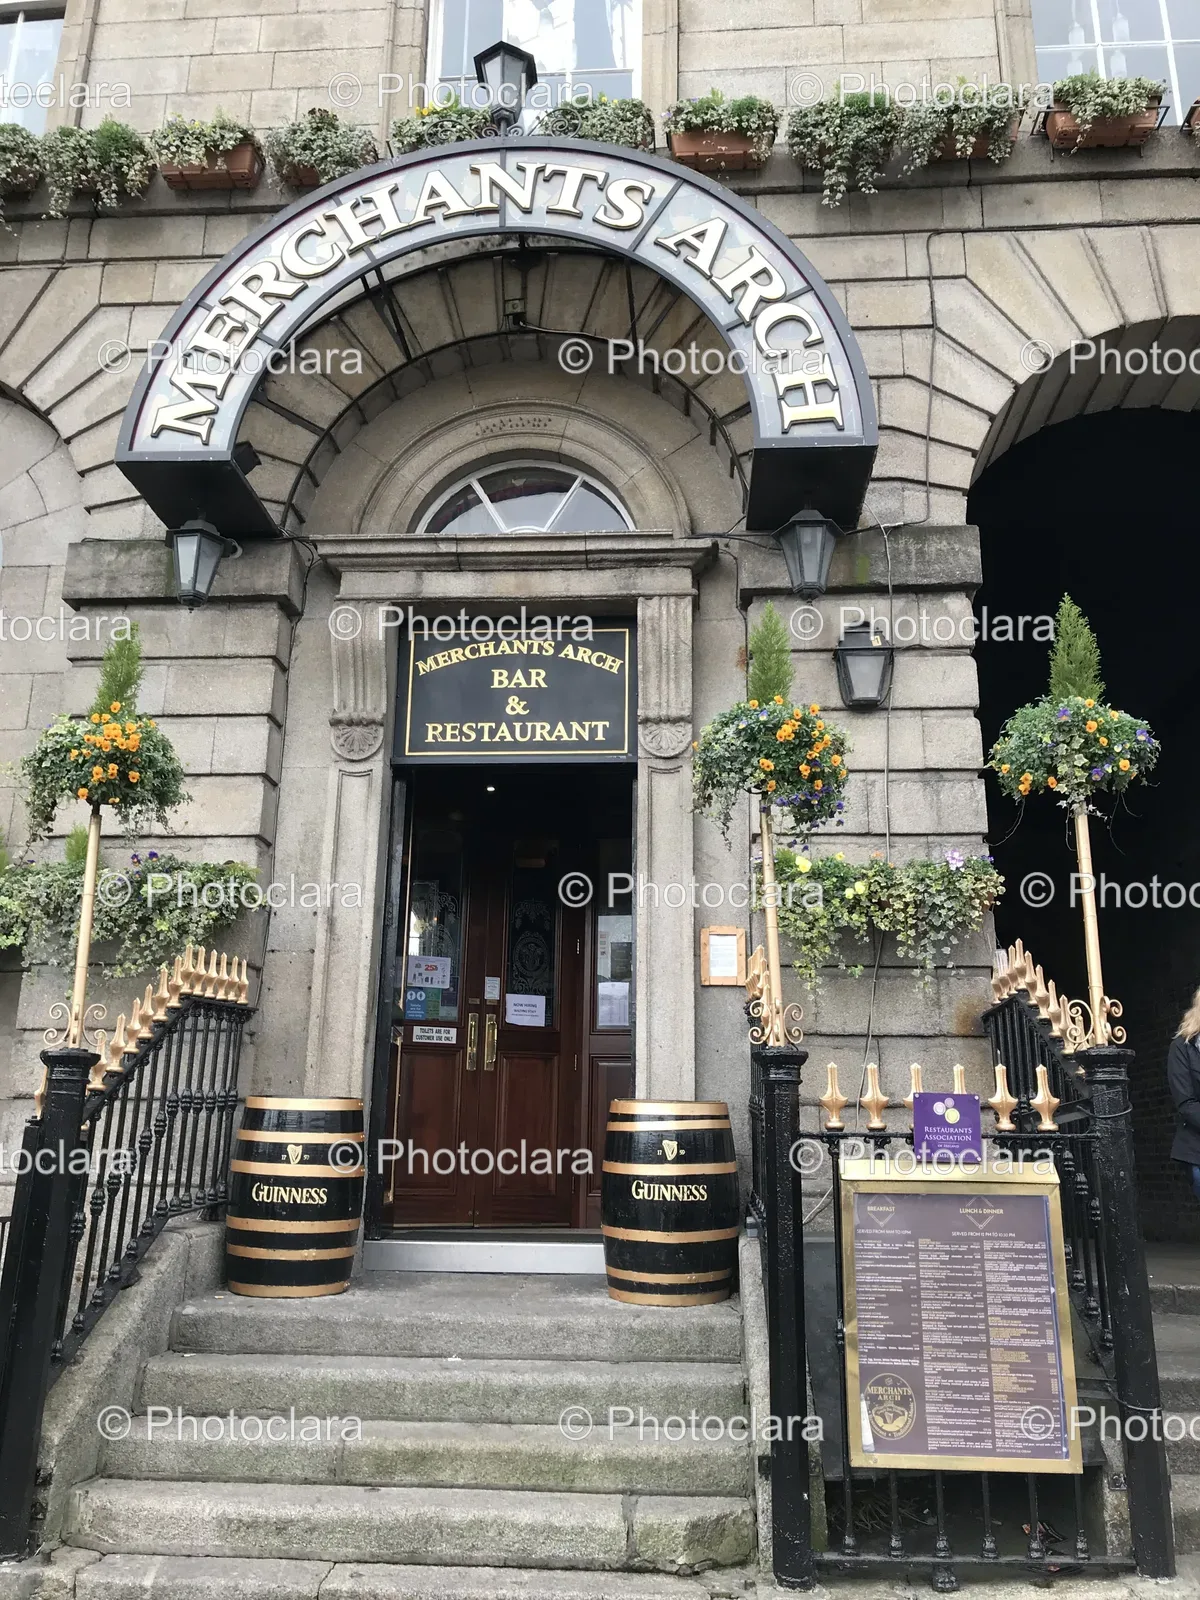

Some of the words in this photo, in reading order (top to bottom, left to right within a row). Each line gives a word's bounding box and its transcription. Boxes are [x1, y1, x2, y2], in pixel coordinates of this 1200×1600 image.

[150, 160, 656, 446] MERCHANTS
[653, 216, 847, 434] ARCH
[415, 639, 555, 676] MERCHANTS
[559, 644, 624, 675] ARCH
[490, 668, 548, 689] BAR
[505, 695, 530, 716] &
[425, 721, 610, 743] RESTAURANT
[252, 1182, 328, 1204] GUINNESS
[631, 1180, 708, 1201] GUINNESS
[867, 1386, 912, 1395] MERCHANTS
